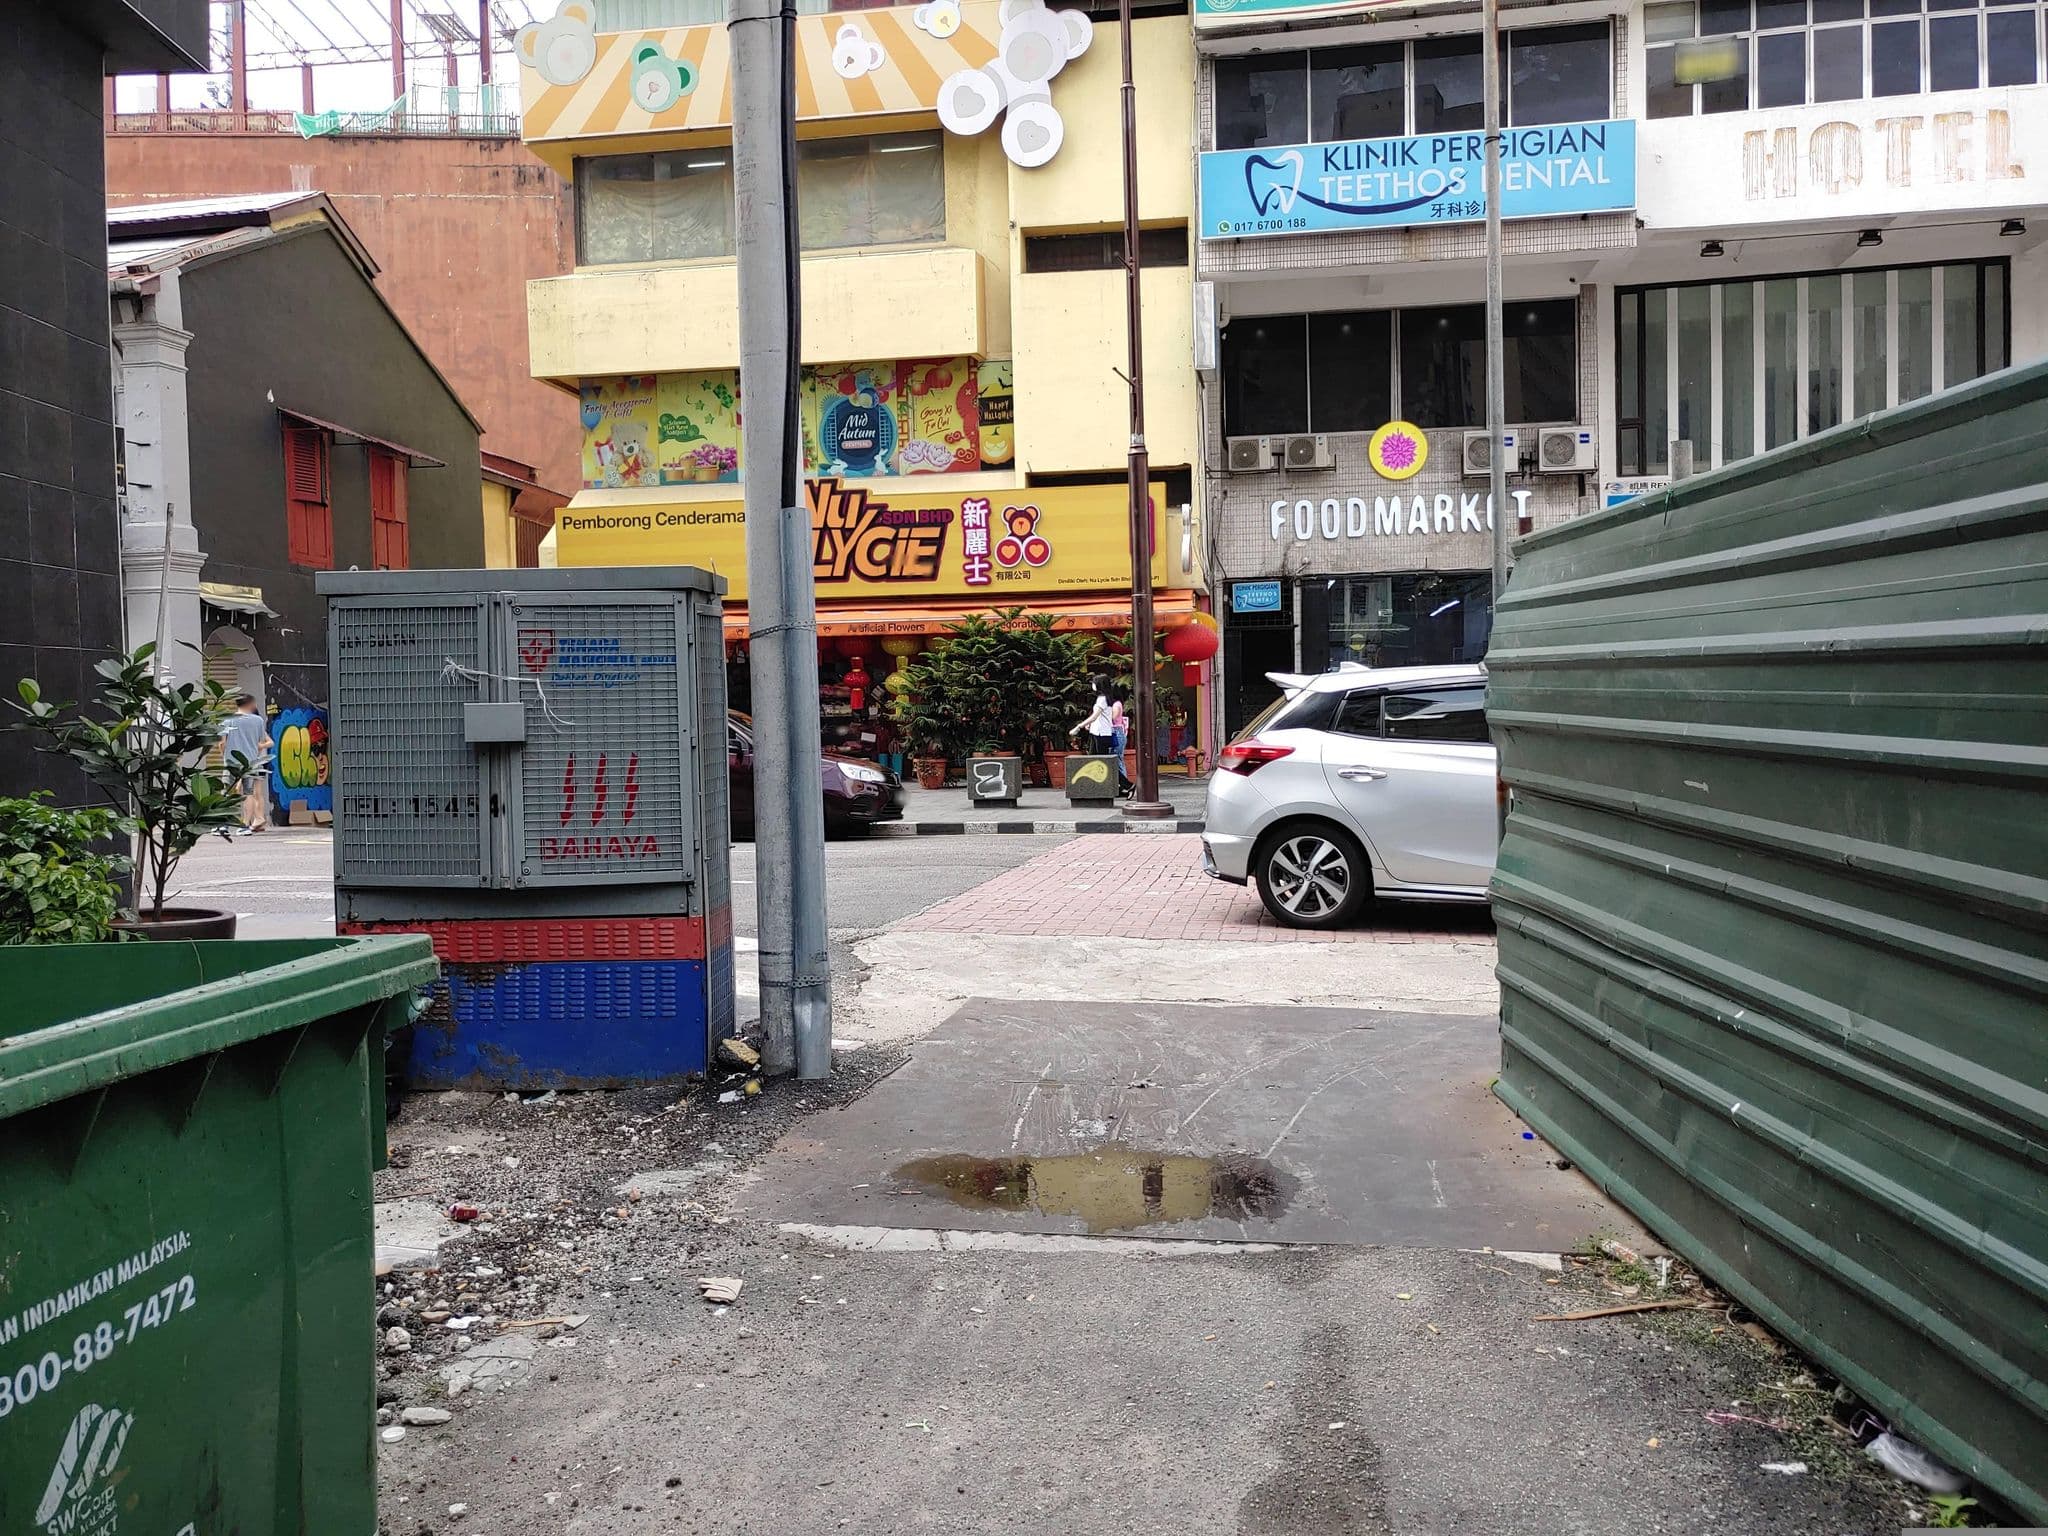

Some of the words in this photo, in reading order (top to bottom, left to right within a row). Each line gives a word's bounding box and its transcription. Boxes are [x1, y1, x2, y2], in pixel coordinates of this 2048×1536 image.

[1323, 140, 1419, 172] KLINIK
[1743, 108, 2026, 201] HOTEL
[1319, 166, 1467, 204] TEETHOS
[1430, 200, 1486, 218] 牙科诊
[1234, 221, 1253, 232] 017
[1257, 219, 1283, 230] 6700
[1287, 217, 1306, 228] 188
[844, 412, 868, 429] Mid
[920, 406, 943, 420] Gong
[562, 515, 651, 531] Pemborong
[882, 510, 915, 524] SDN
[920, 509, 953, 523] BHD
[1270, 490, 1533, 540] FOODMARKT
[963, 499, 990, 582] 新麗士
[995, 570, 1031, 581] 有限公司
[888, 621, 926, 632] Flowers
[541, 835, 661, 860] BAHAYA
[23, 1264, 115, 1334] INDAHKAN
[117, 1229, 192, 1286] MALAYSIA:
